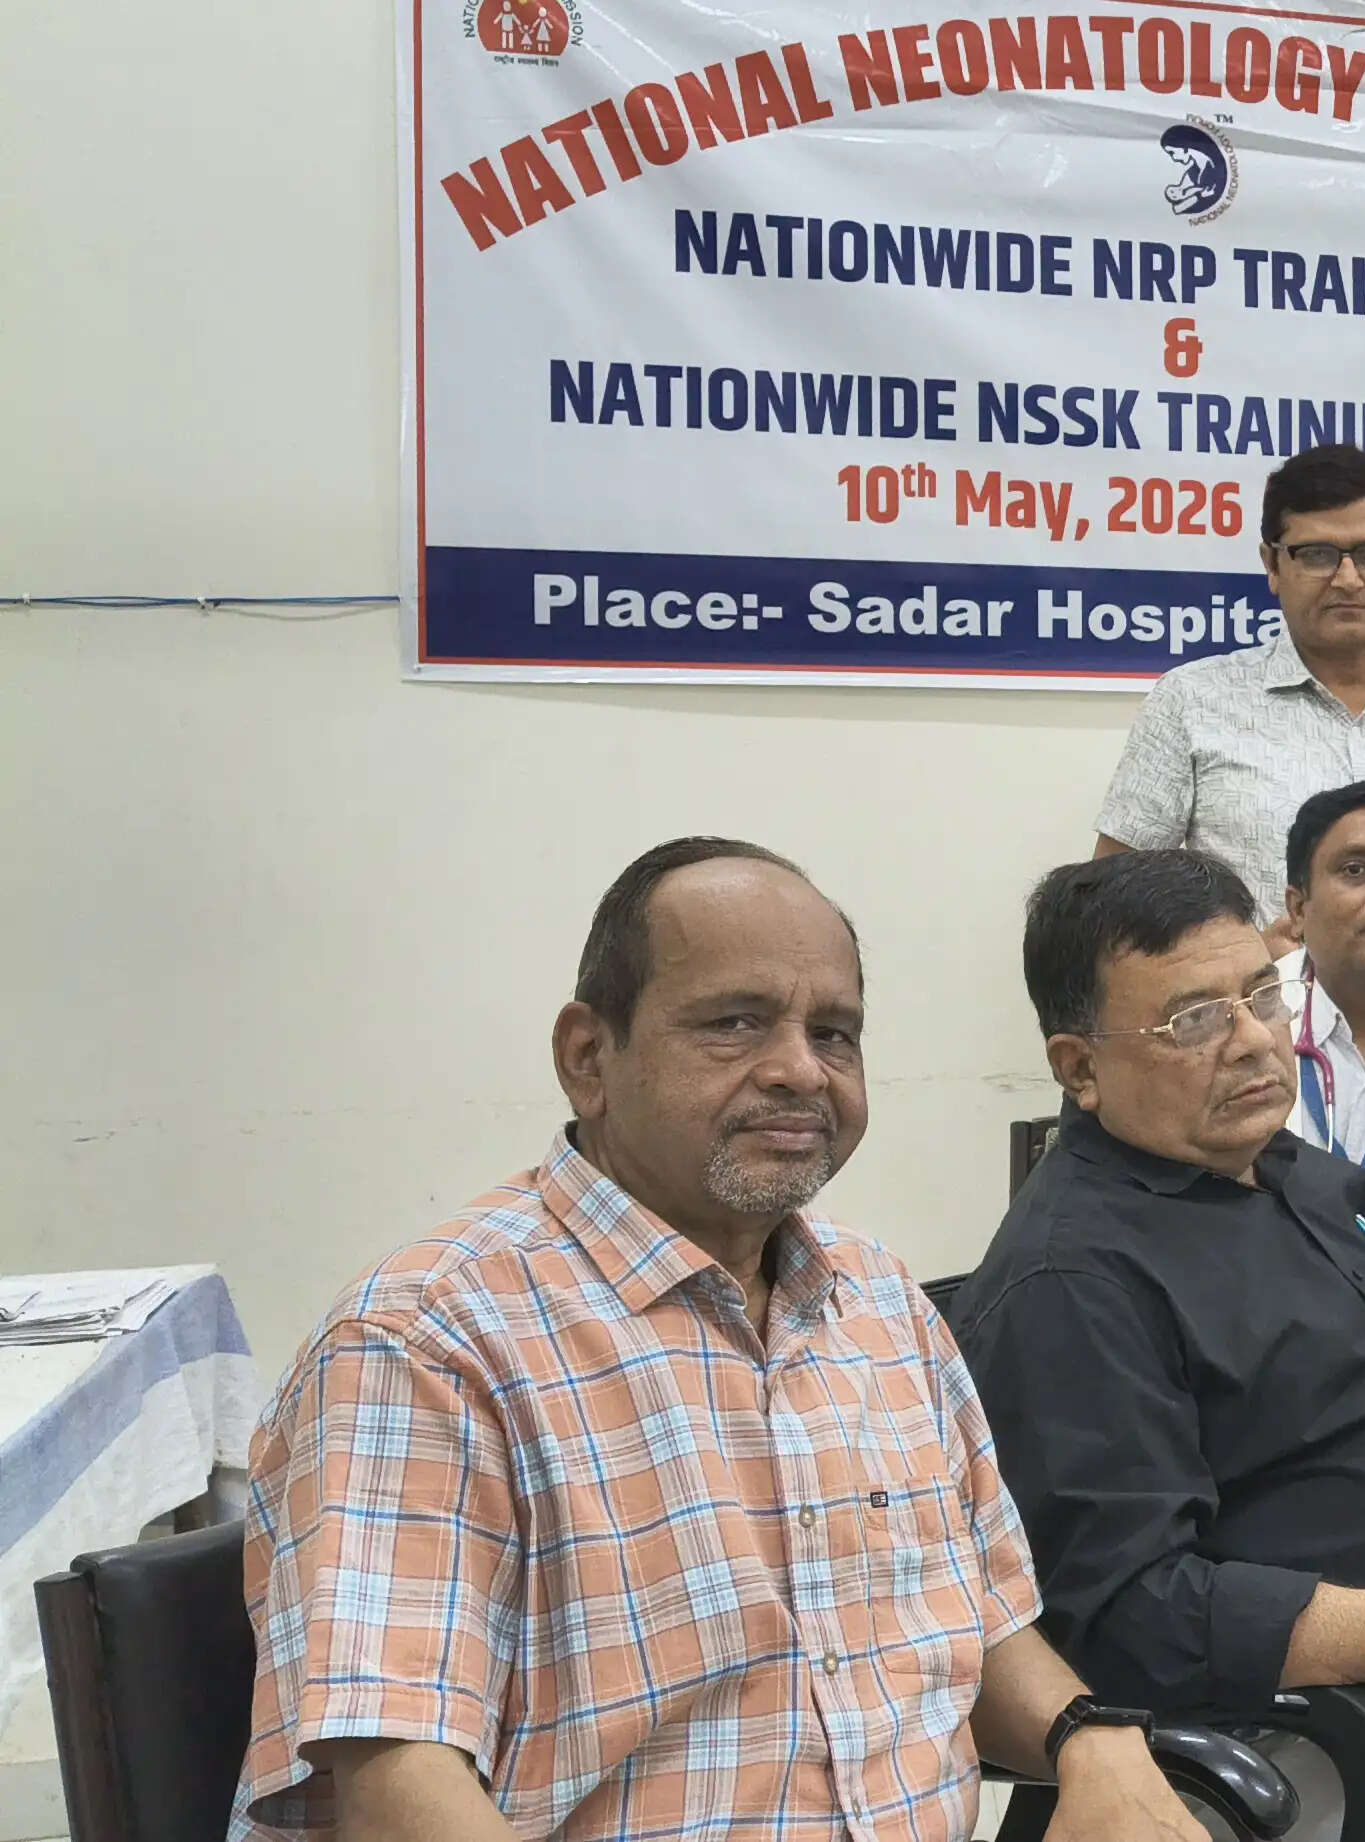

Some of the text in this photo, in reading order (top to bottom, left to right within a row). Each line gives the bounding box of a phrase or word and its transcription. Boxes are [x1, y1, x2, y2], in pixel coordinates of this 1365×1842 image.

[441, 43, 833, 252] NATIONAL
[674, 208, 1073, 297] NATIONWIDE
[1093, 238, 1217, 304] NRP
[1164, 318, 1204, 379] &
[550, 359, 957, 441] NATIONWIDE
[977, 380, 1141, 450] NSSK
[838, 463, 1244, 542] 10th May, 2026
[534, 574, 783, 630] Place:-
[807, 581, 1014, 637] Sadar
[1037, 589, 1287, 655] Hospita
